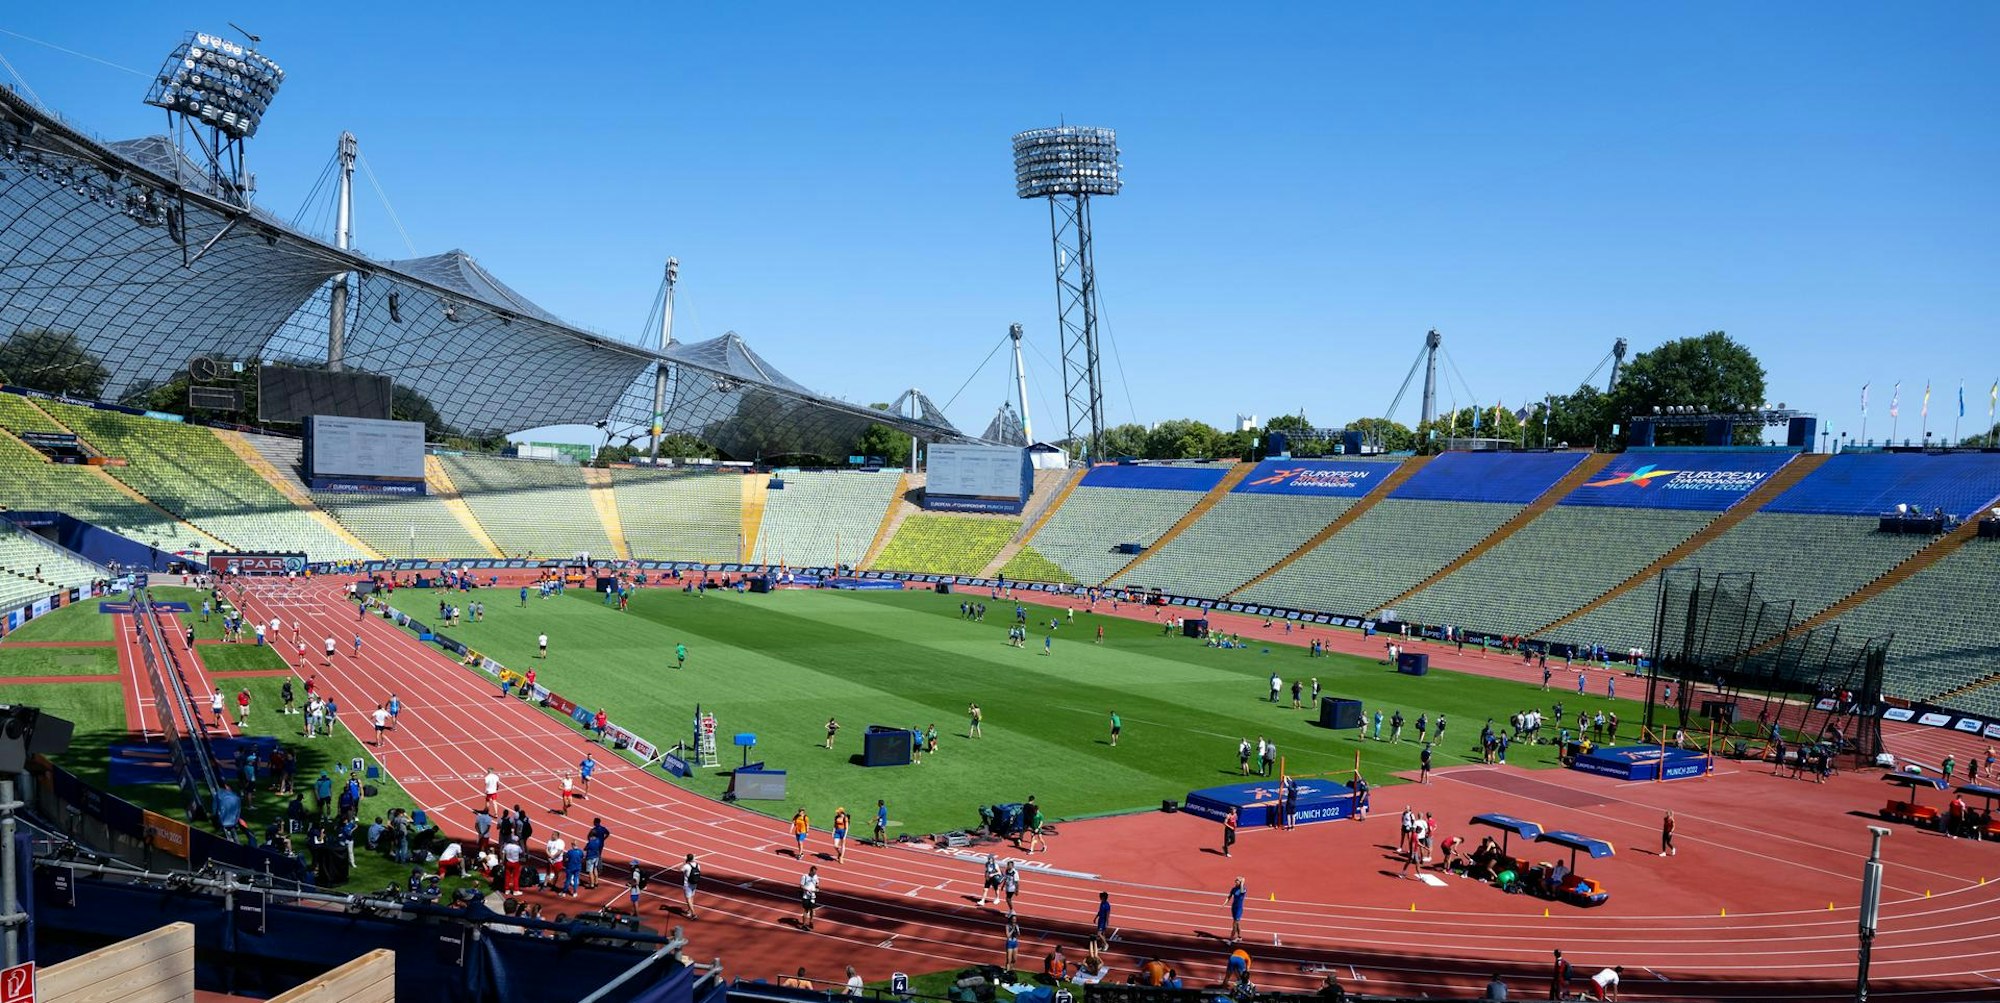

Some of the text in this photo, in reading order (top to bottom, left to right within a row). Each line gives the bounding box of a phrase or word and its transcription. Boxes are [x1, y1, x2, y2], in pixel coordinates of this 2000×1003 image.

[1300, 470, 1370, 478] EUROPEAN
[1675, 470, 1767, 480] EUROPEAN
[227, 559, 283, 568] SPAR
[1666, 767, 1686, 776] MUNICH
[1322, 806, 1340, 818] 2022
[896, 981, 904, 991] 4
